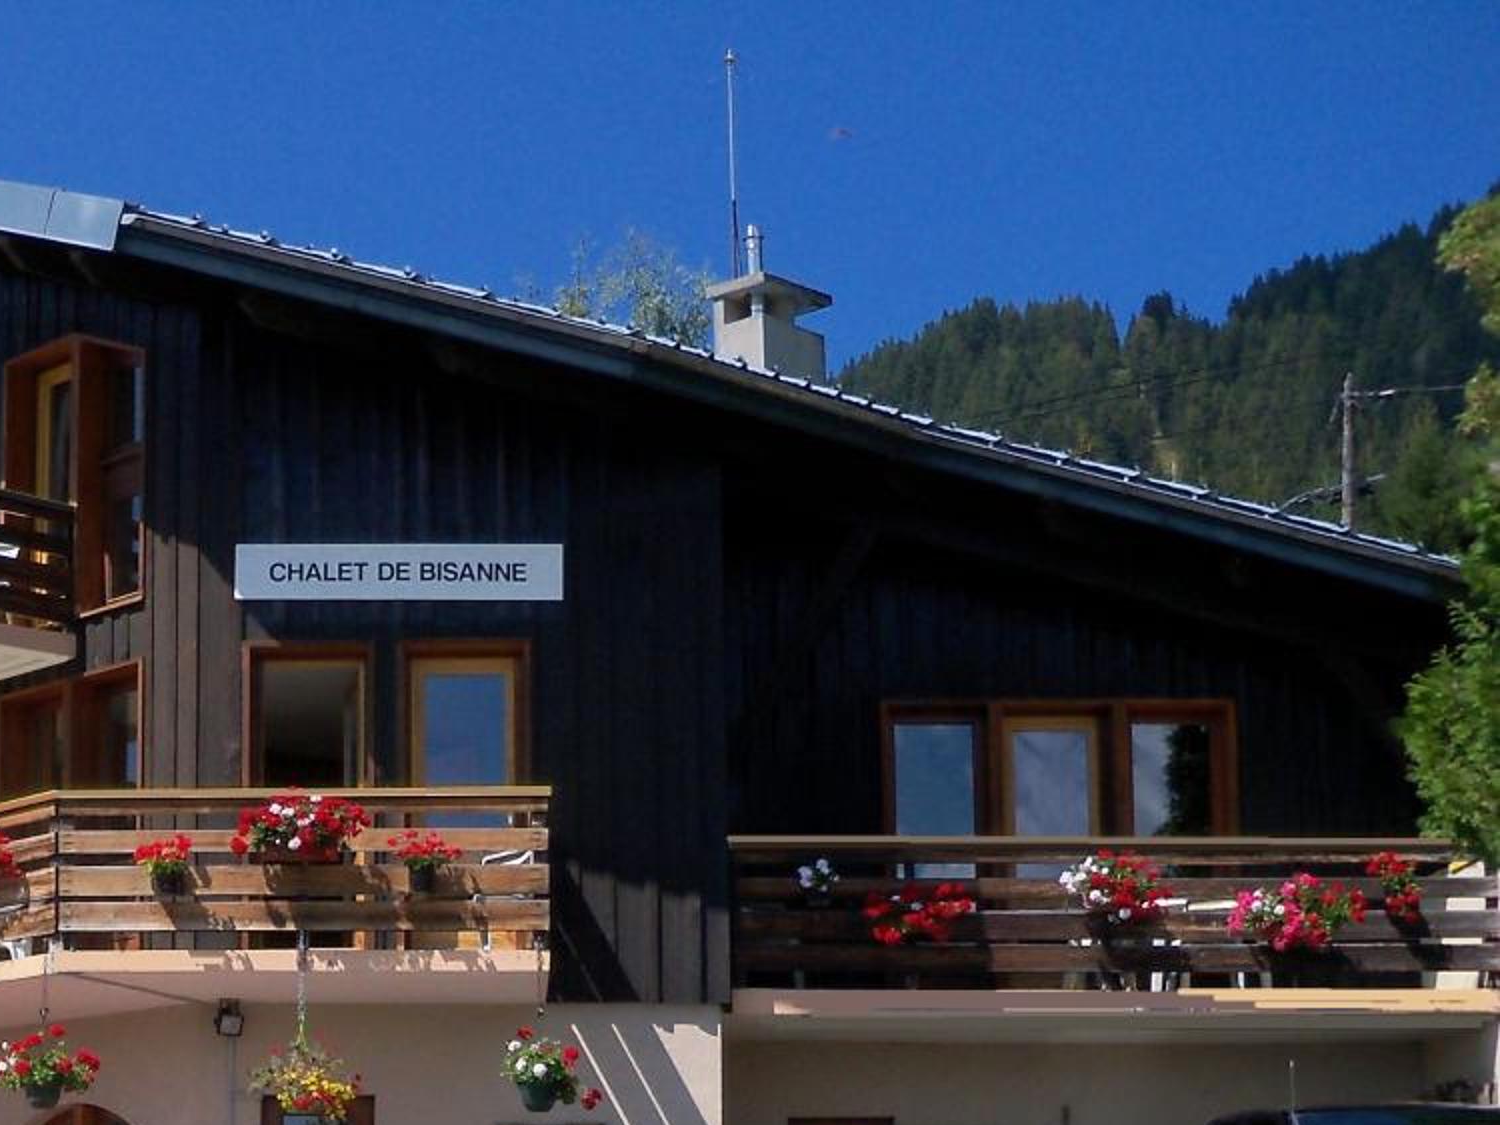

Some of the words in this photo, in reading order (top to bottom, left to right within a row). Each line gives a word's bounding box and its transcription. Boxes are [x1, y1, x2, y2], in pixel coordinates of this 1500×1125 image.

[268, 562, 369, 582] CHALET
[378, 562, 411, 582] DE
[419, 562, 527, 582] BISANNE
